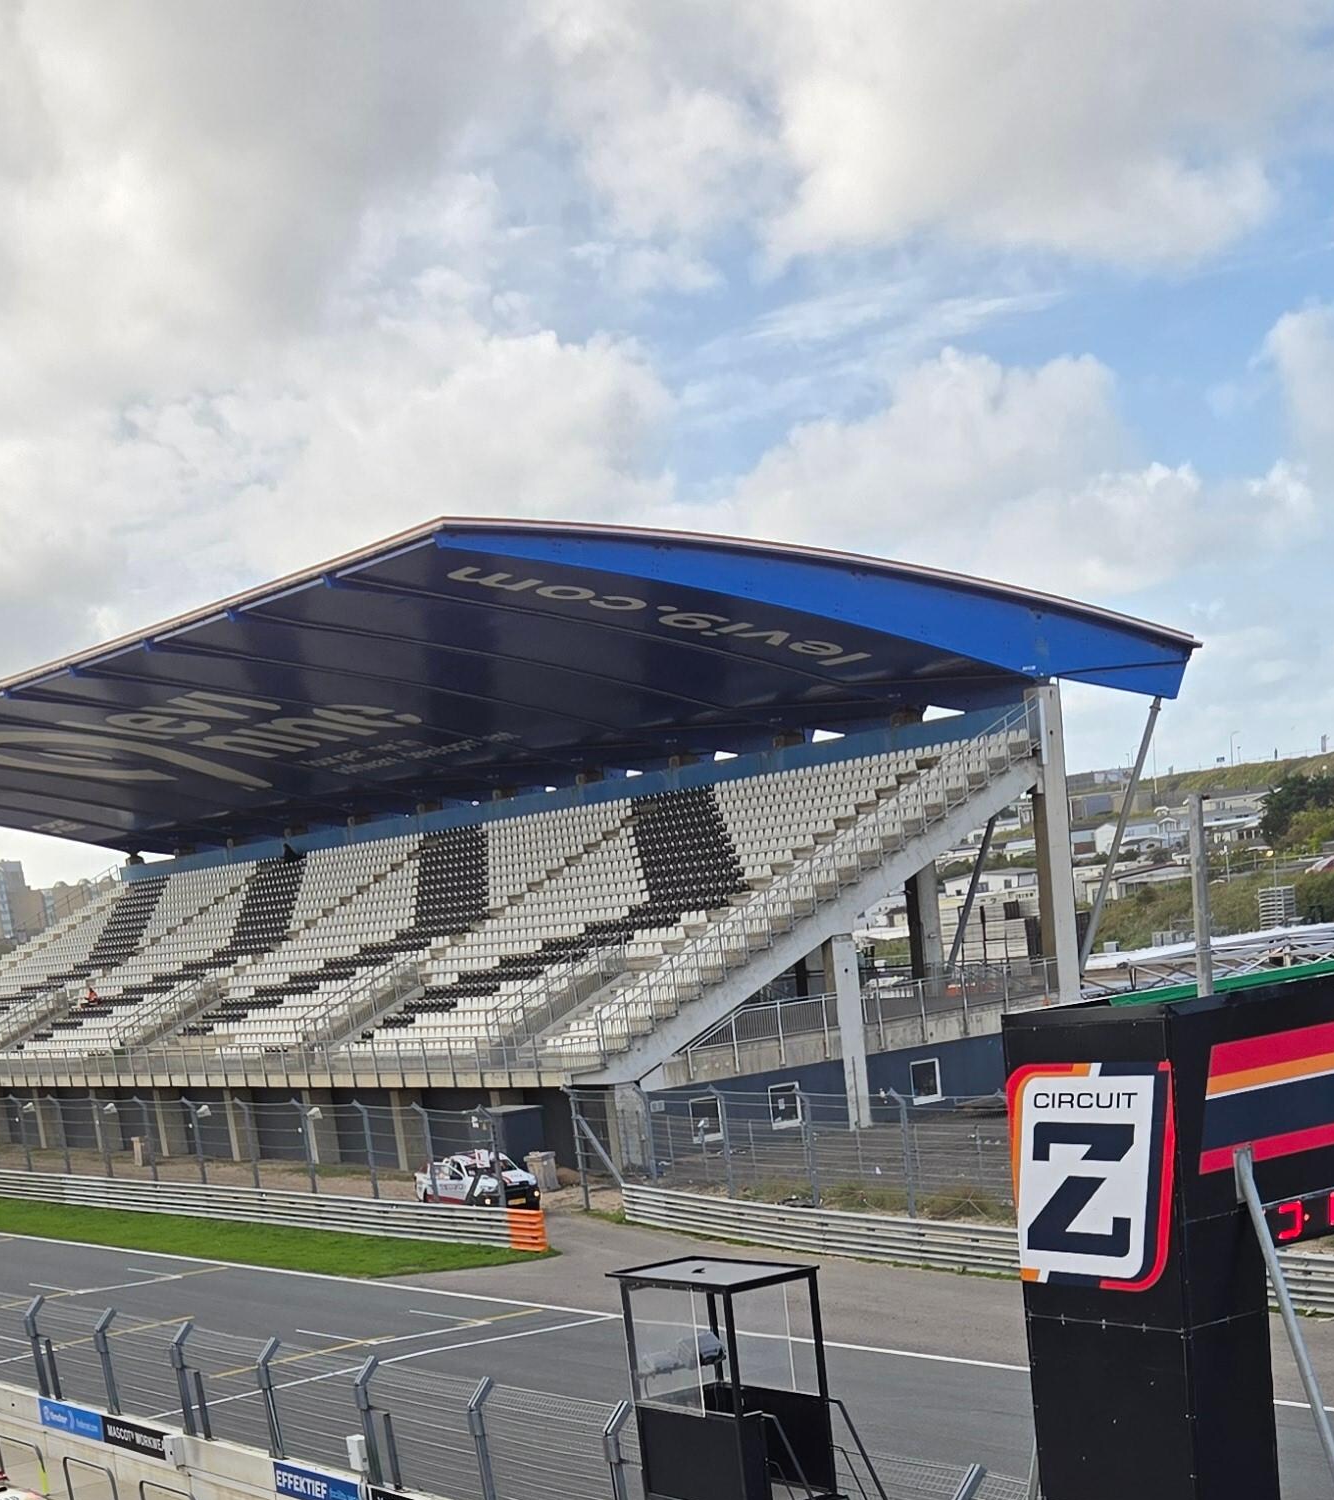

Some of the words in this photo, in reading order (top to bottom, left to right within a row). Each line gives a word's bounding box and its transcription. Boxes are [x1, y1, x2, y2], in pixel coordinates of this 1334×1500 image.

[447, 567, 871, 667] levi9.com
[1032, 1090, 1138, 1111] CIRCUIT
[1027, 1122, 1136, 1257] Z
[275, 1470, 327, 1499] EFFEKTIEF
